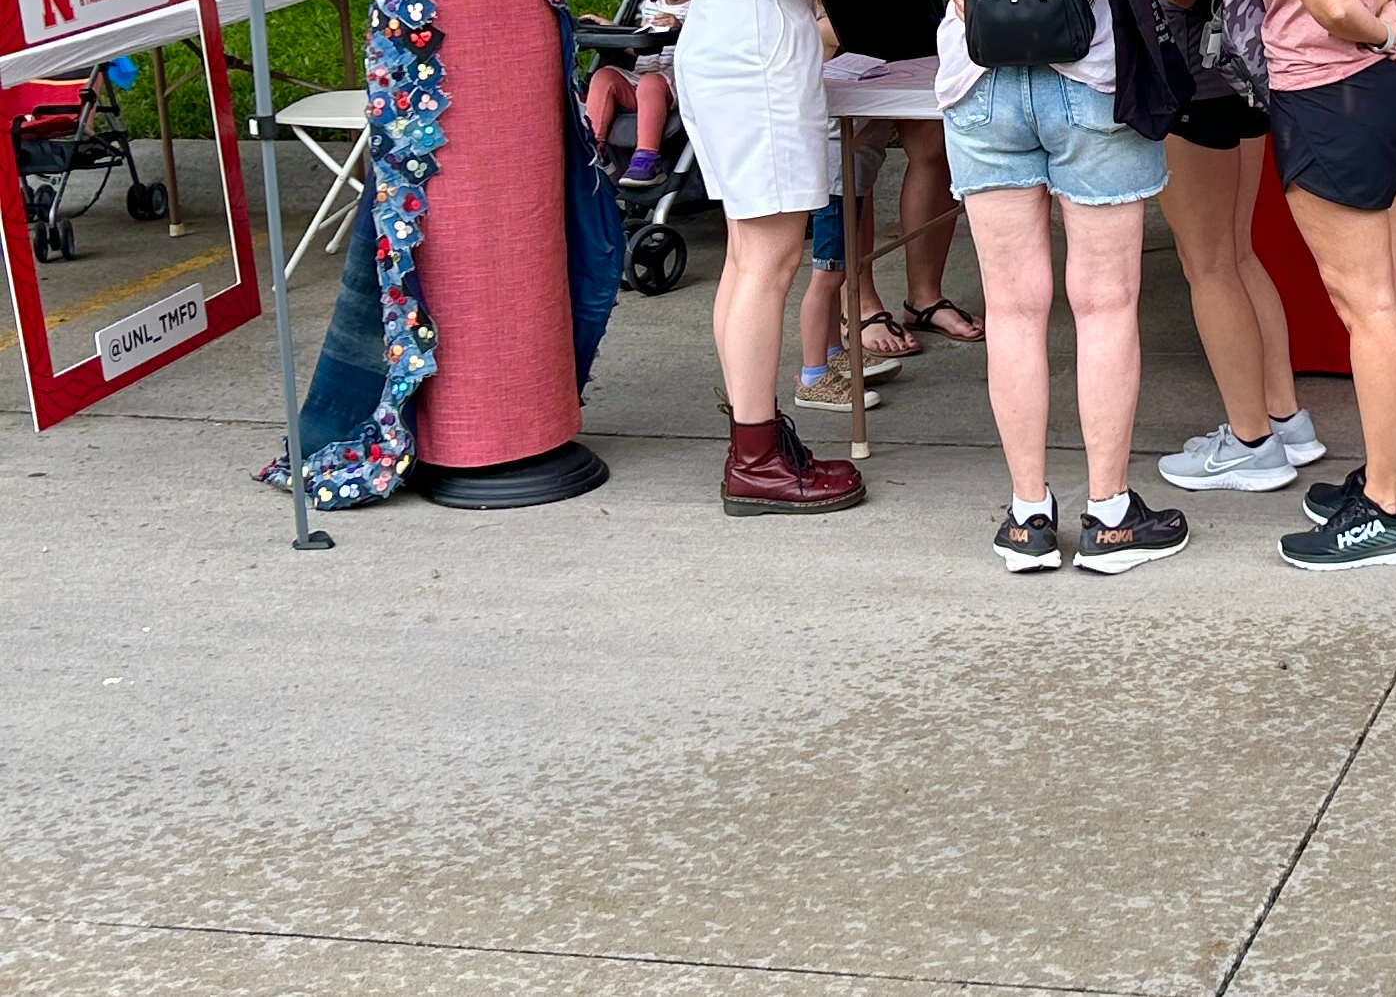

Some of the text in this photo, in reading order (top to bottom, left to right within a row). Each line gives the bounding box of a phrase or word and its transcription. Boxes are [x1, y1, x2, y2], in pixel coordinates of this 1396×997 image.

[108, 300, 198, 363] @UNL_TMFD
[1095, 529, 1134, 544] HOKA
[1337, 518, 1386, 550] HOKA
